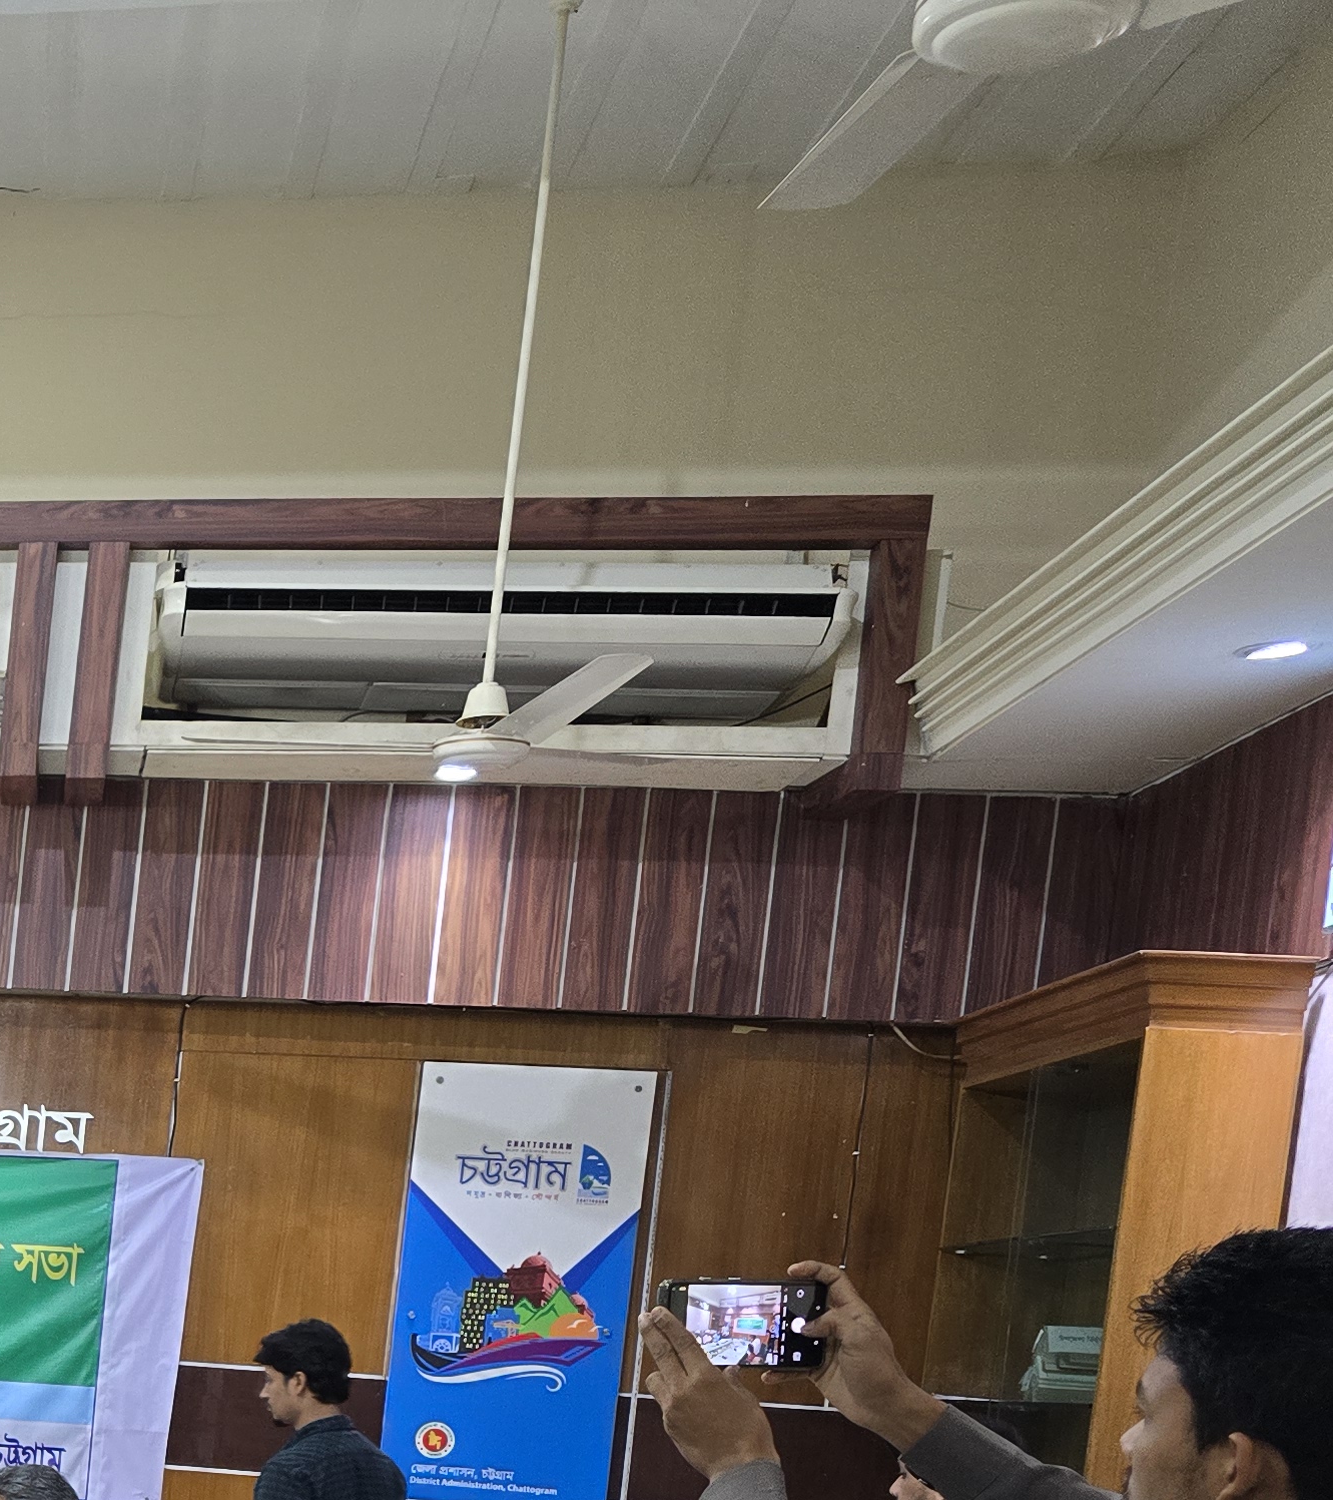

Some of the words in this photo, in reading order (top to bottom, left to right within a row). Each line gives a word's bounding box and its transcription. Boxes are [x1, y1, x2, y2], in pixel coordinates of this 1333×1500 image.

[507, 1140, 572, 1150] CHATTOGRAM
[456, 1145, 572, 1191] চট্টগ্রাম
[12, 1243, 84, 1286] সভা
[409, 1476, 440, 1486] District
[441, 1479, 506, 1492] Administration,
[507, 1484, 558, 1496] Chattogram
